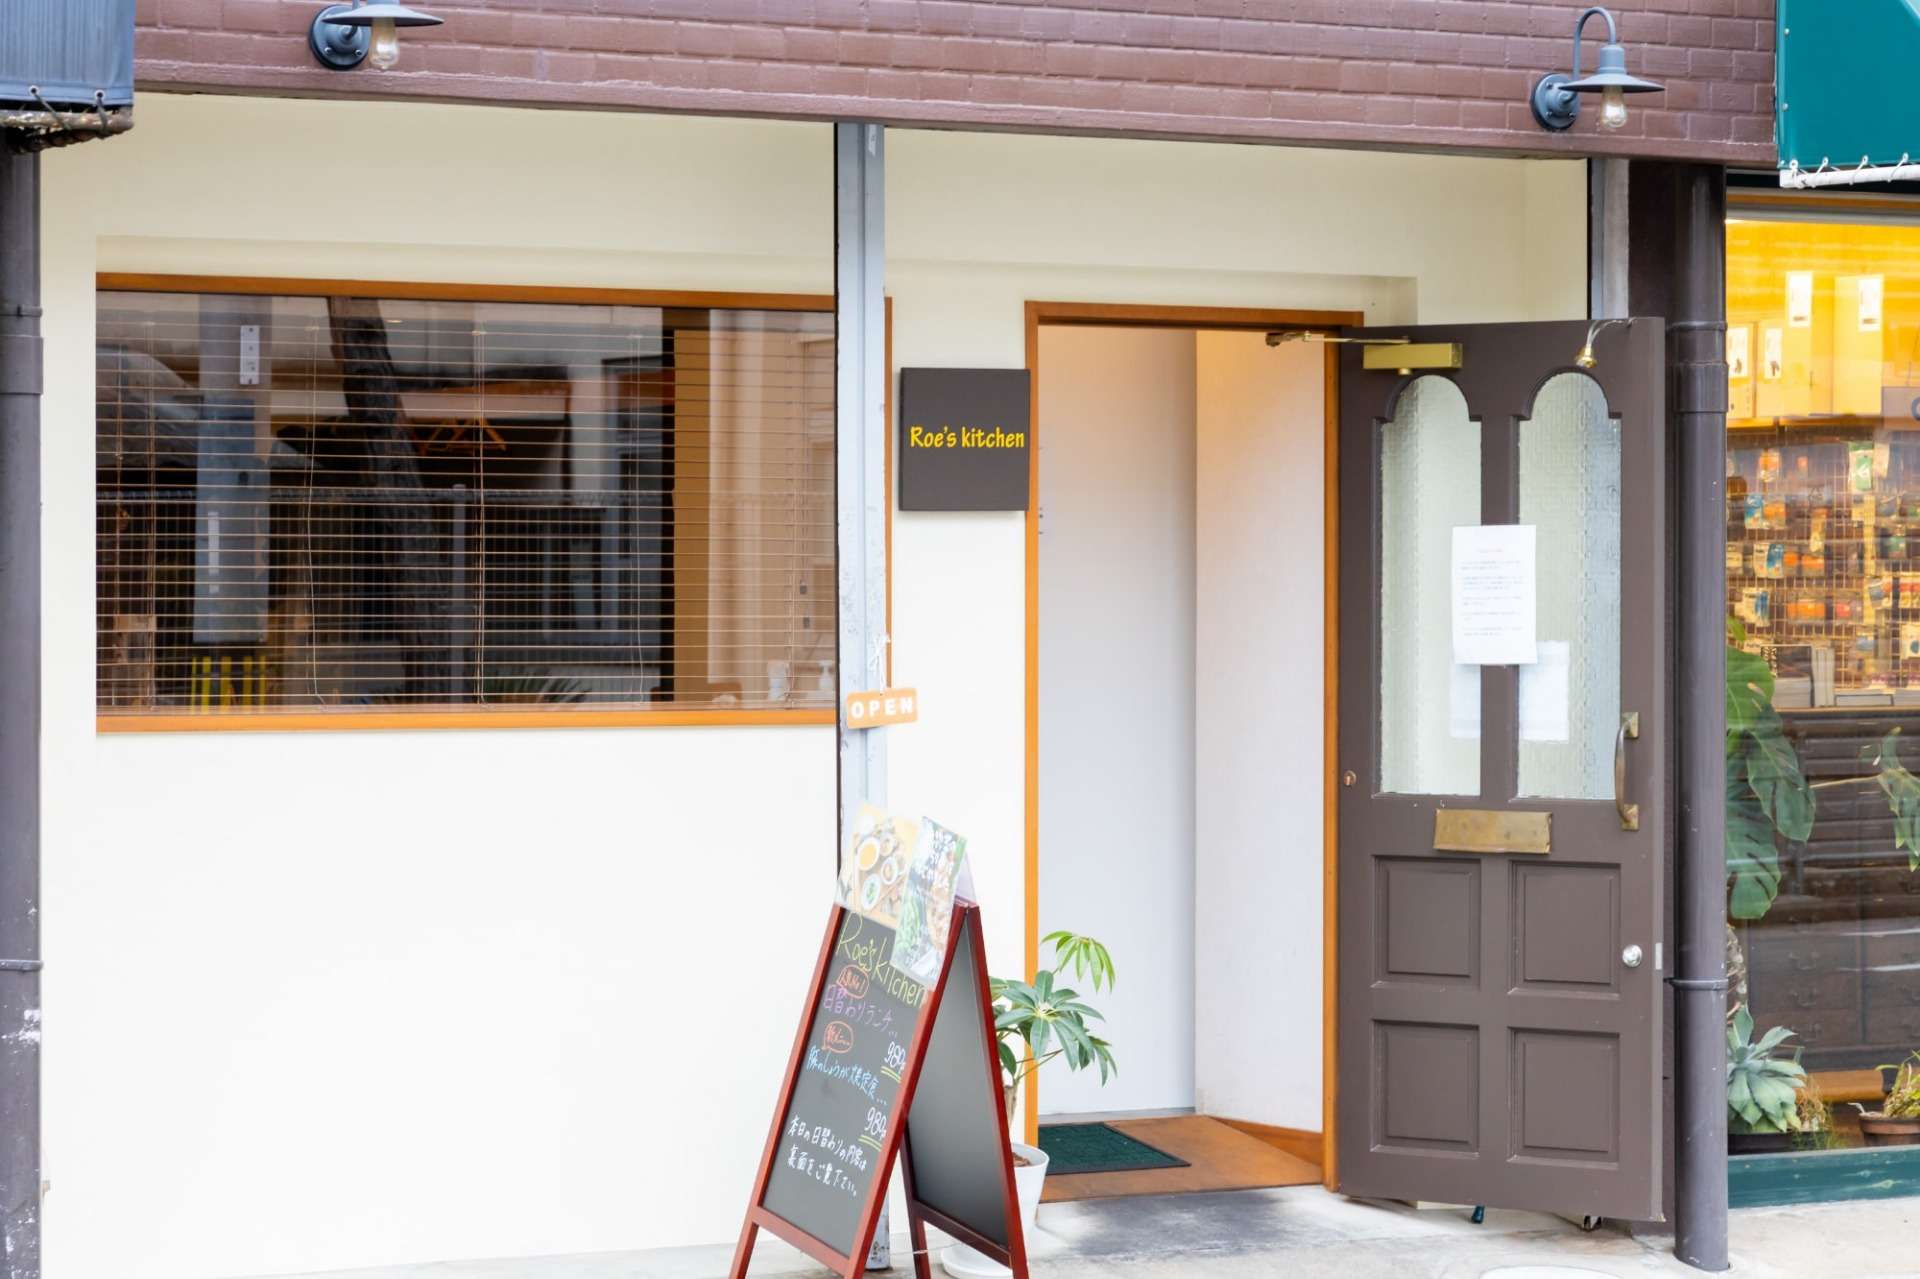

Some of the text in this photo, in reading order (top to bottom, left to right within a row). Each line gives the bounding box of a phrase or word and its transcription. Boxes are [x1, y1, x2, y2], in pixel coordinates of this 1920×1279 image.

[910, 425, 1025, 448] Roe's kitchen
[851, 697, 913, 720] OPEN
